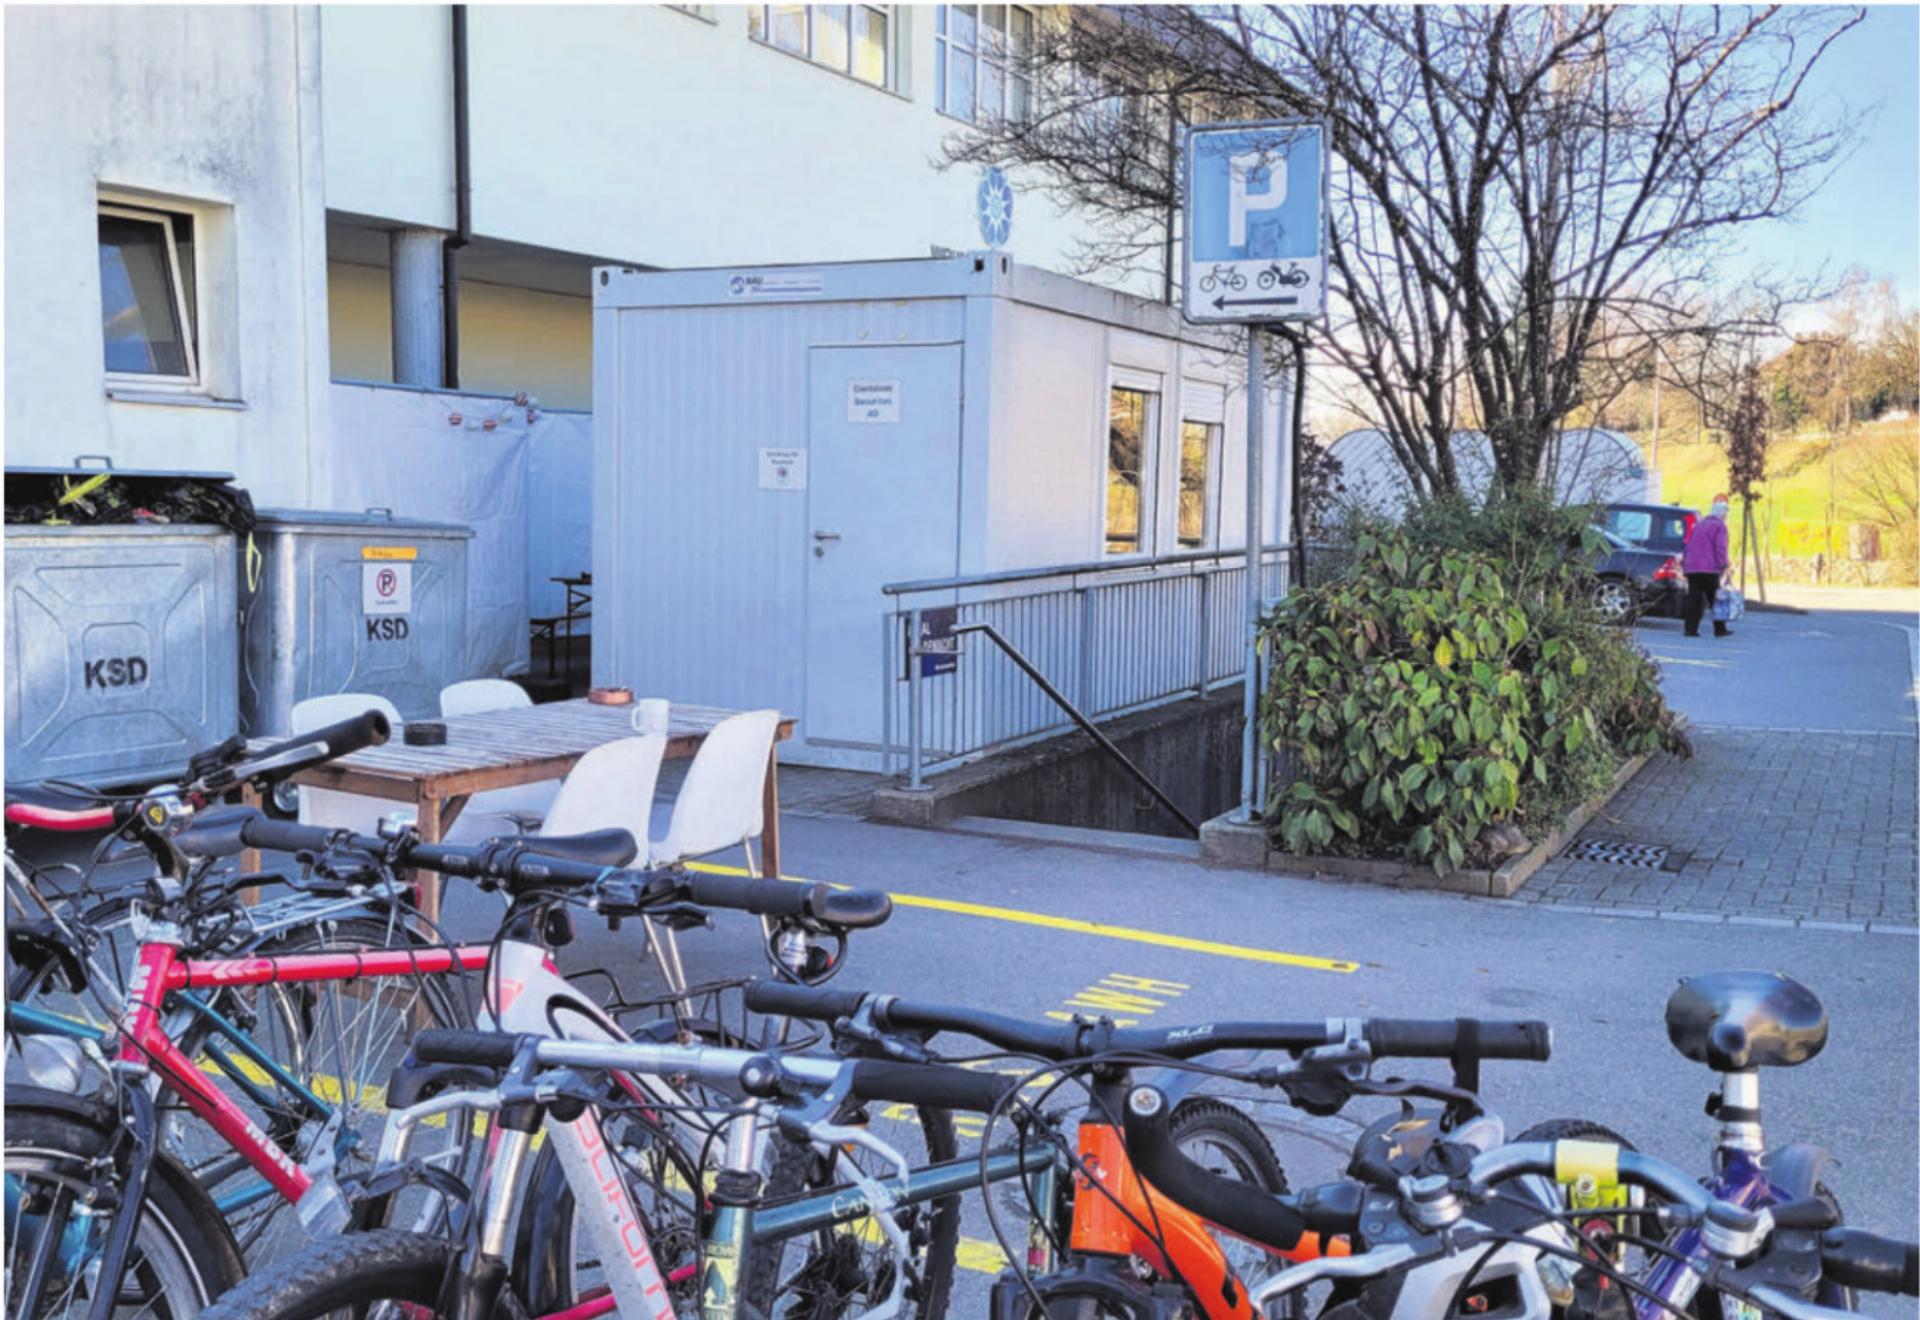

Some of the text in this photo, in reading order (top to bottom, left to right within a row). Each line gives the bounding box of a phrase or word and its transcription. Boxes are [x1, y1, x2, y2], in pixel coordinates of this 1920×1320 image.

[1229, 151, 1288, 248] P
[367, 618, 409, 641] KSD
[84, 656, 148, 690] KSD
